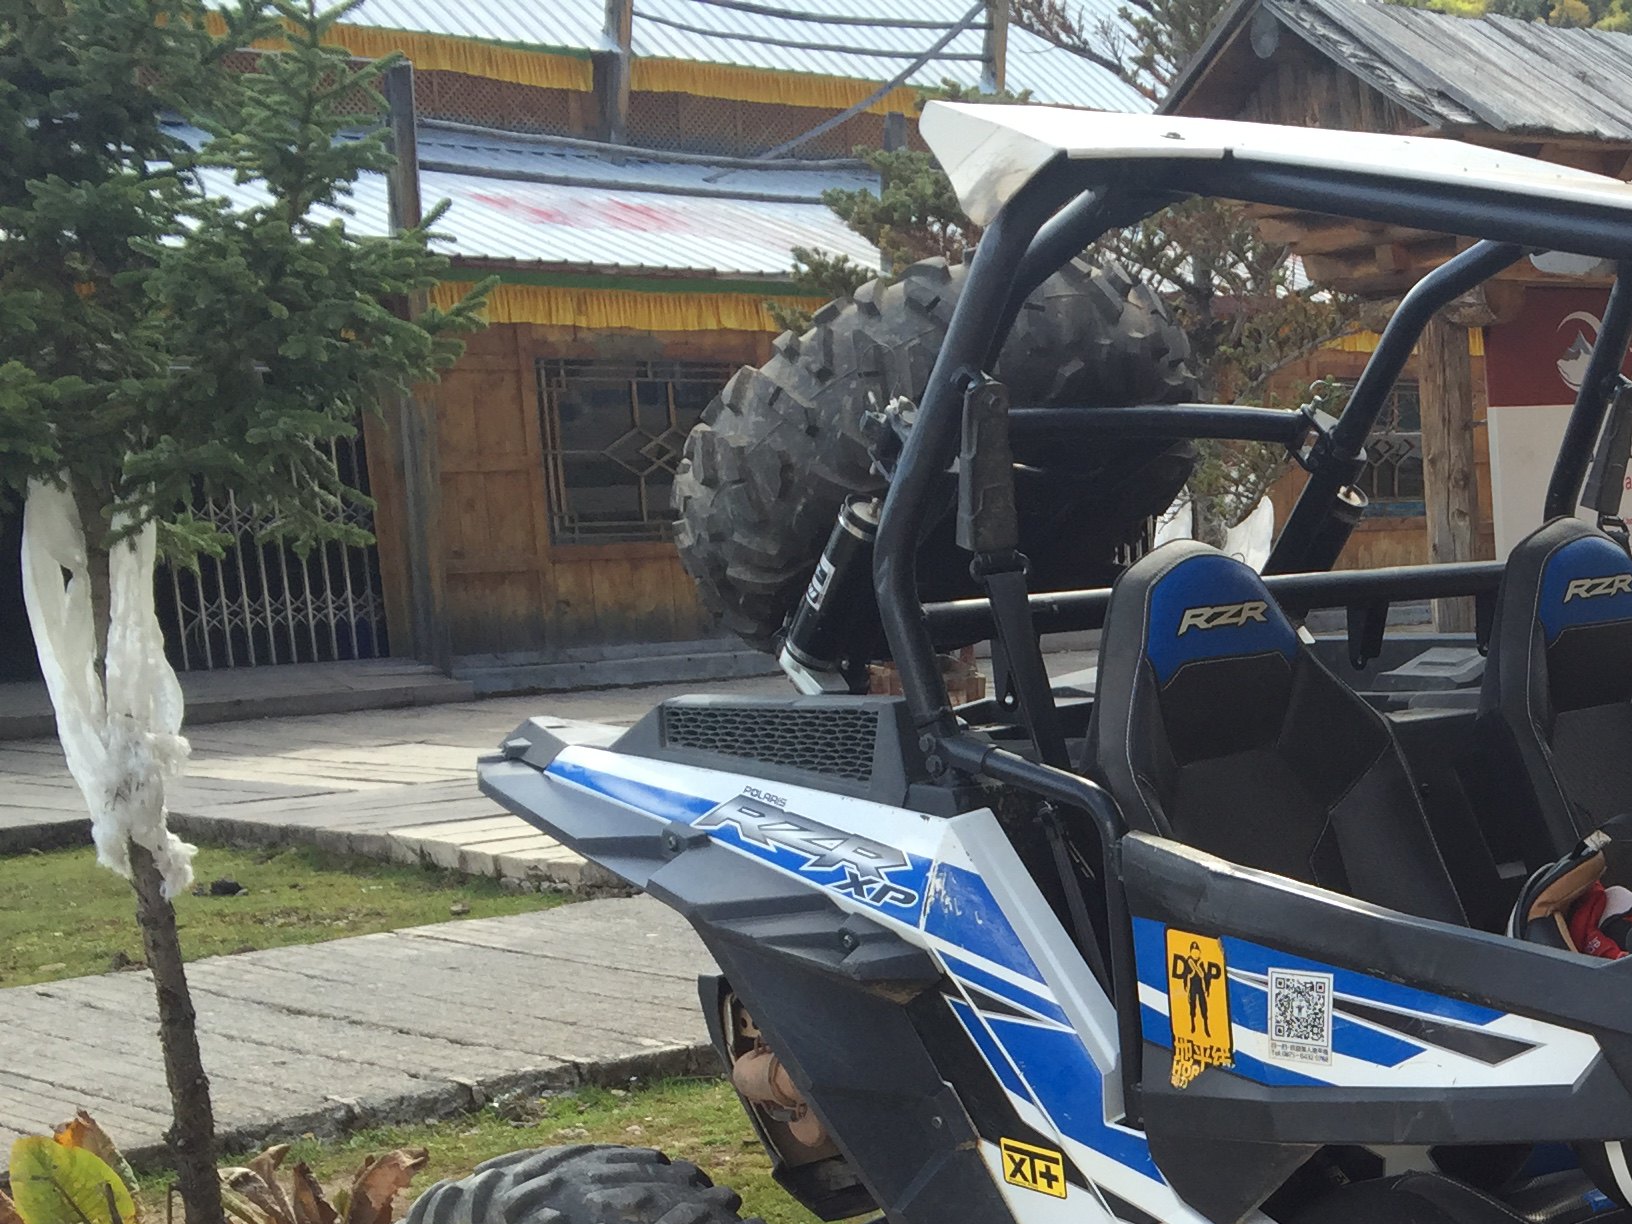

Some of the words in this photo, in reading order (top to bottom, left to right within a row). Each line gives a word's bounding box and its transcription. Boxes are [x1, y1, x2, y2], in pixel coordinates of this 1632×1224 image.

[1563, 574, 1632, 603] RZR
[1177, 600, 1268, 636] RZR
[743, 785, 788, 807] POLARIS
[692, 795, 911, 880] RZR
[837, 870, 918, 908] XP
